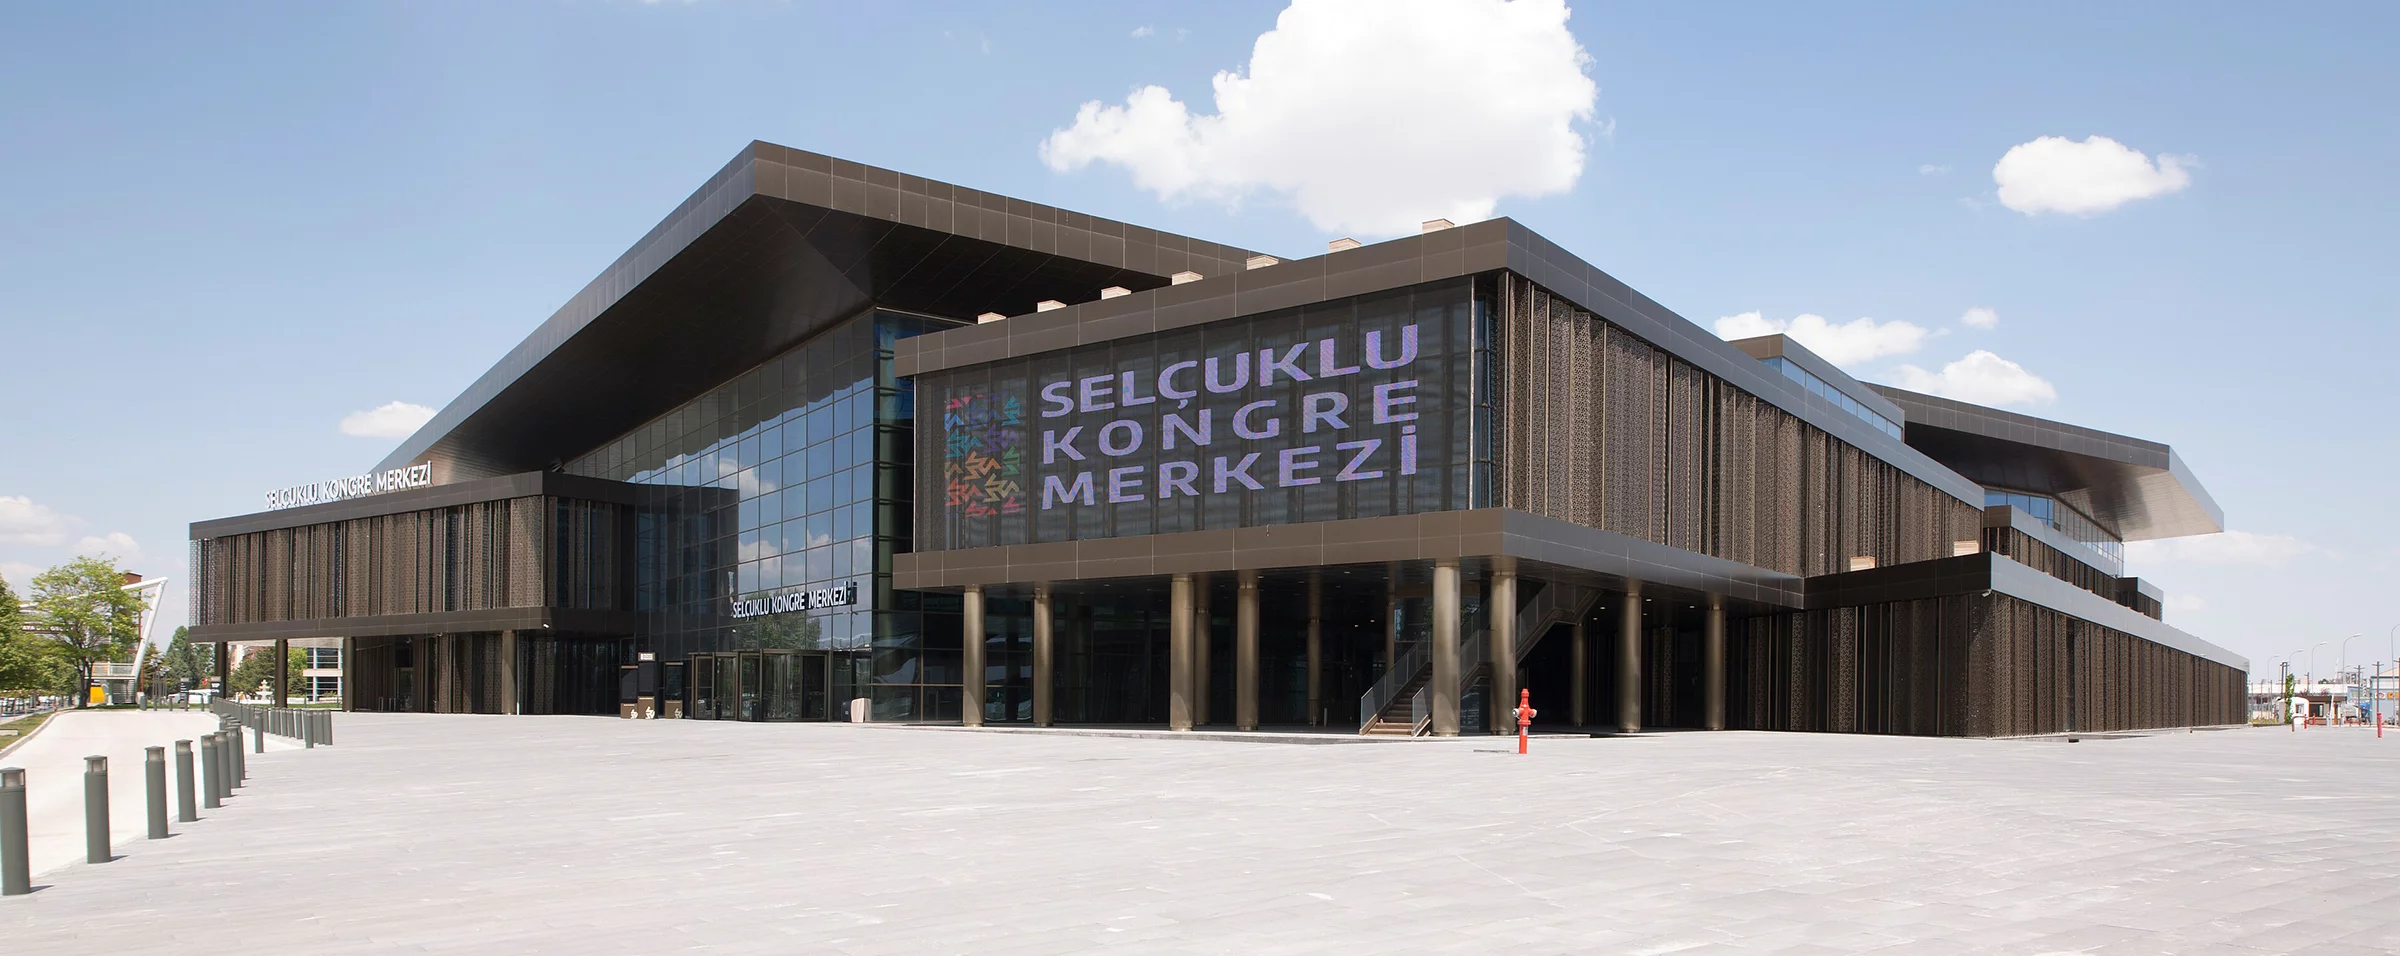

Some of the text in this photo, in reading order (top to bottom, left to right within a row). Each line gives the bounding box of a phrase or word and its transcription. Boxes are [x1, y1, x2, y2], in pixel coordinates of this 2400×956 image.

[1040, 324, 1419, 418] SELÇUKLU
[1042, 379, 1419, 464] KONGRE
[322, 473, 374, 500] KONGRE
[376, 460, 432, 492] MERKEZİ
[1041, 424, 1418, 510] MERKEZİ
[732, 580, 848, 621] SELÇUKLU KONGRE MERKEZİ
